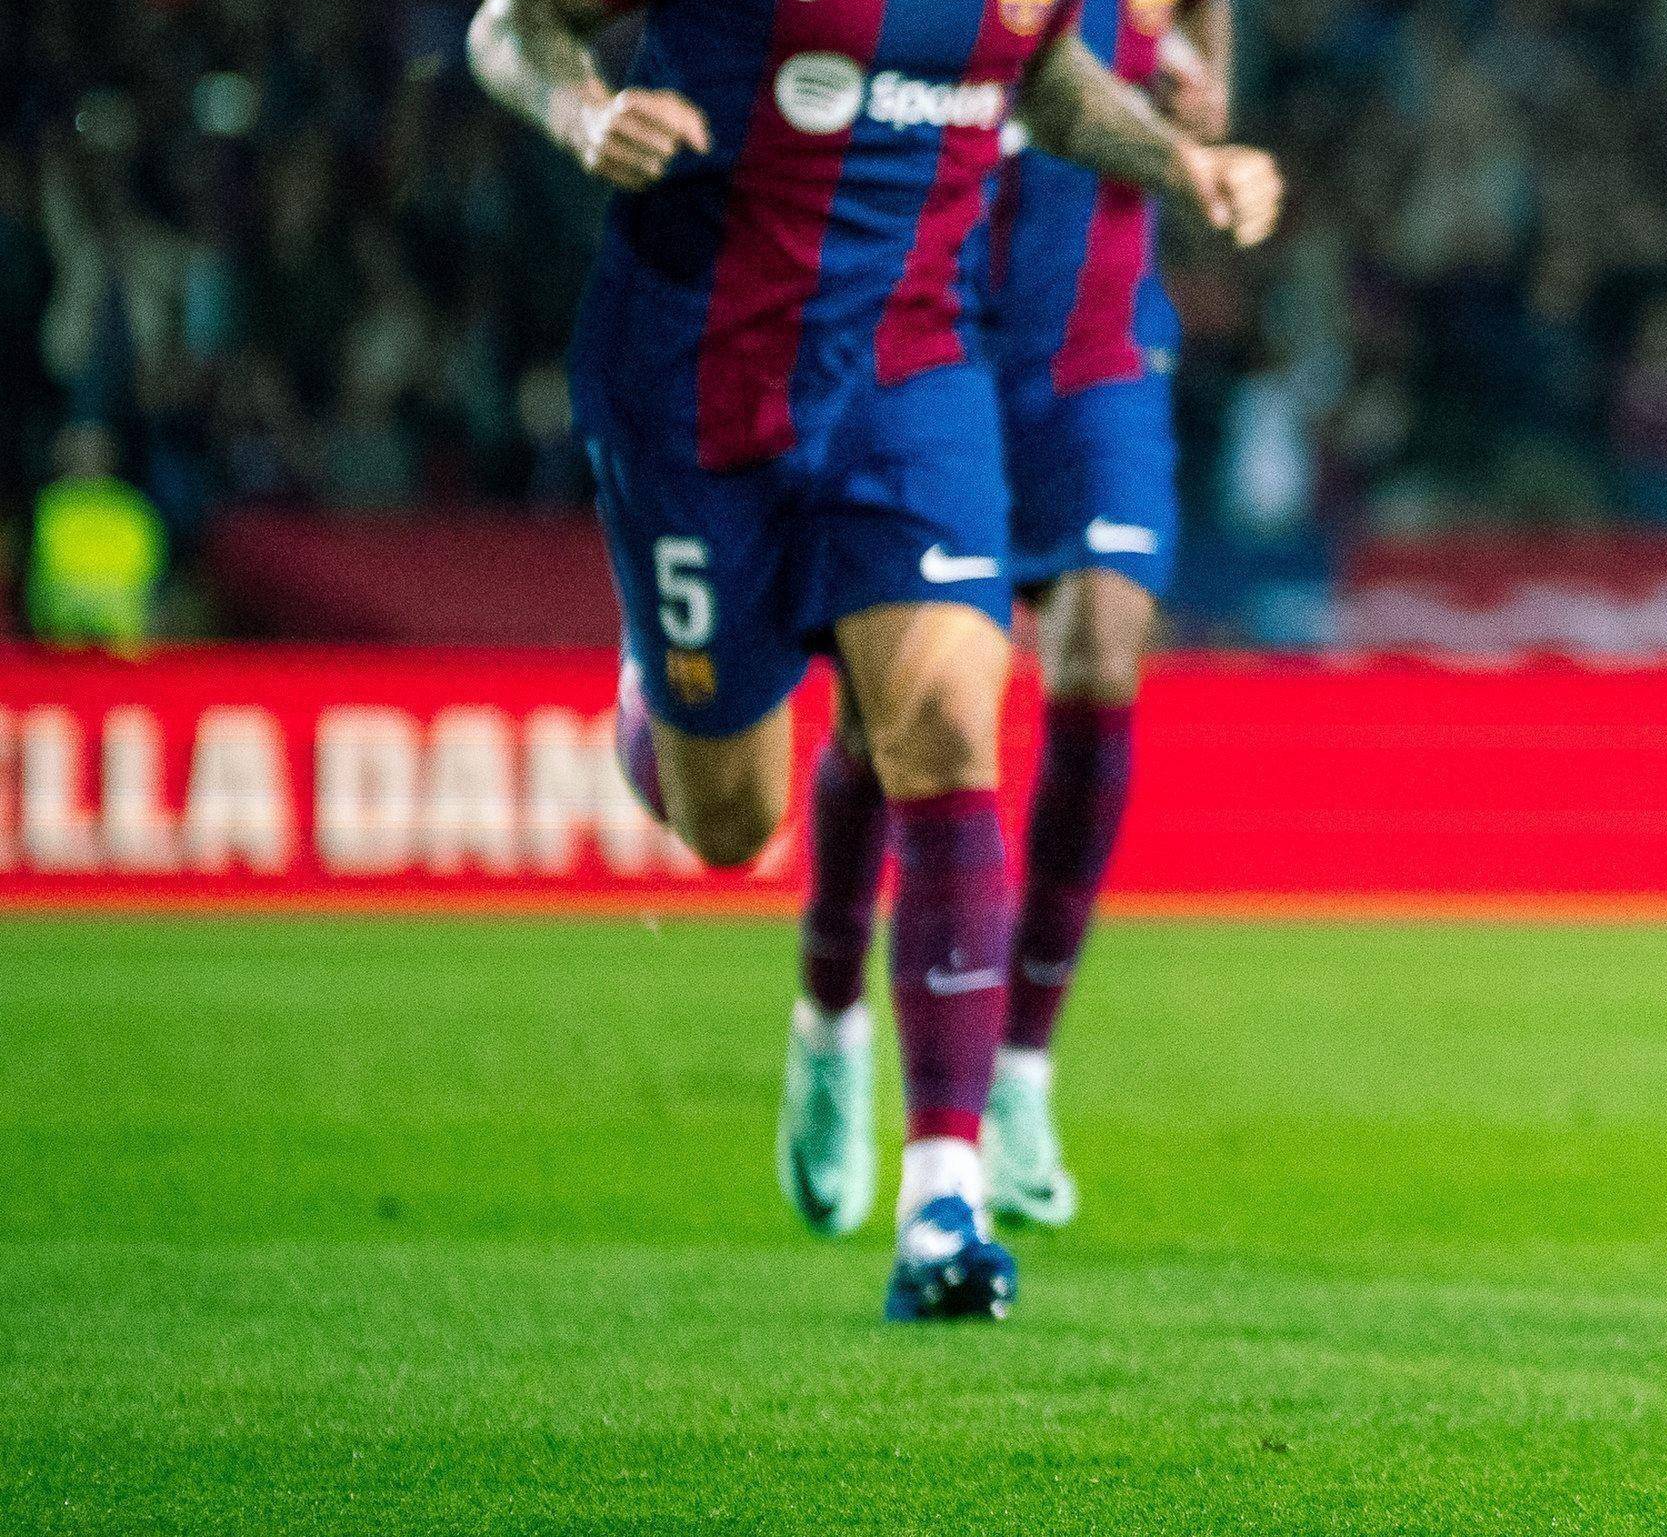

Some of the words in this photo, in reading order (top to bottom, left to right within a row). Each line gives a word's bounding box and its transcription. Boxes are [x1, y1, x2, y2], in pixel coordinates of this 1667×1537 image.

[653, 536, 717, 650] 5
[0, 704, 293, 876] LLA
[316, 704, 795, 877] DAM
